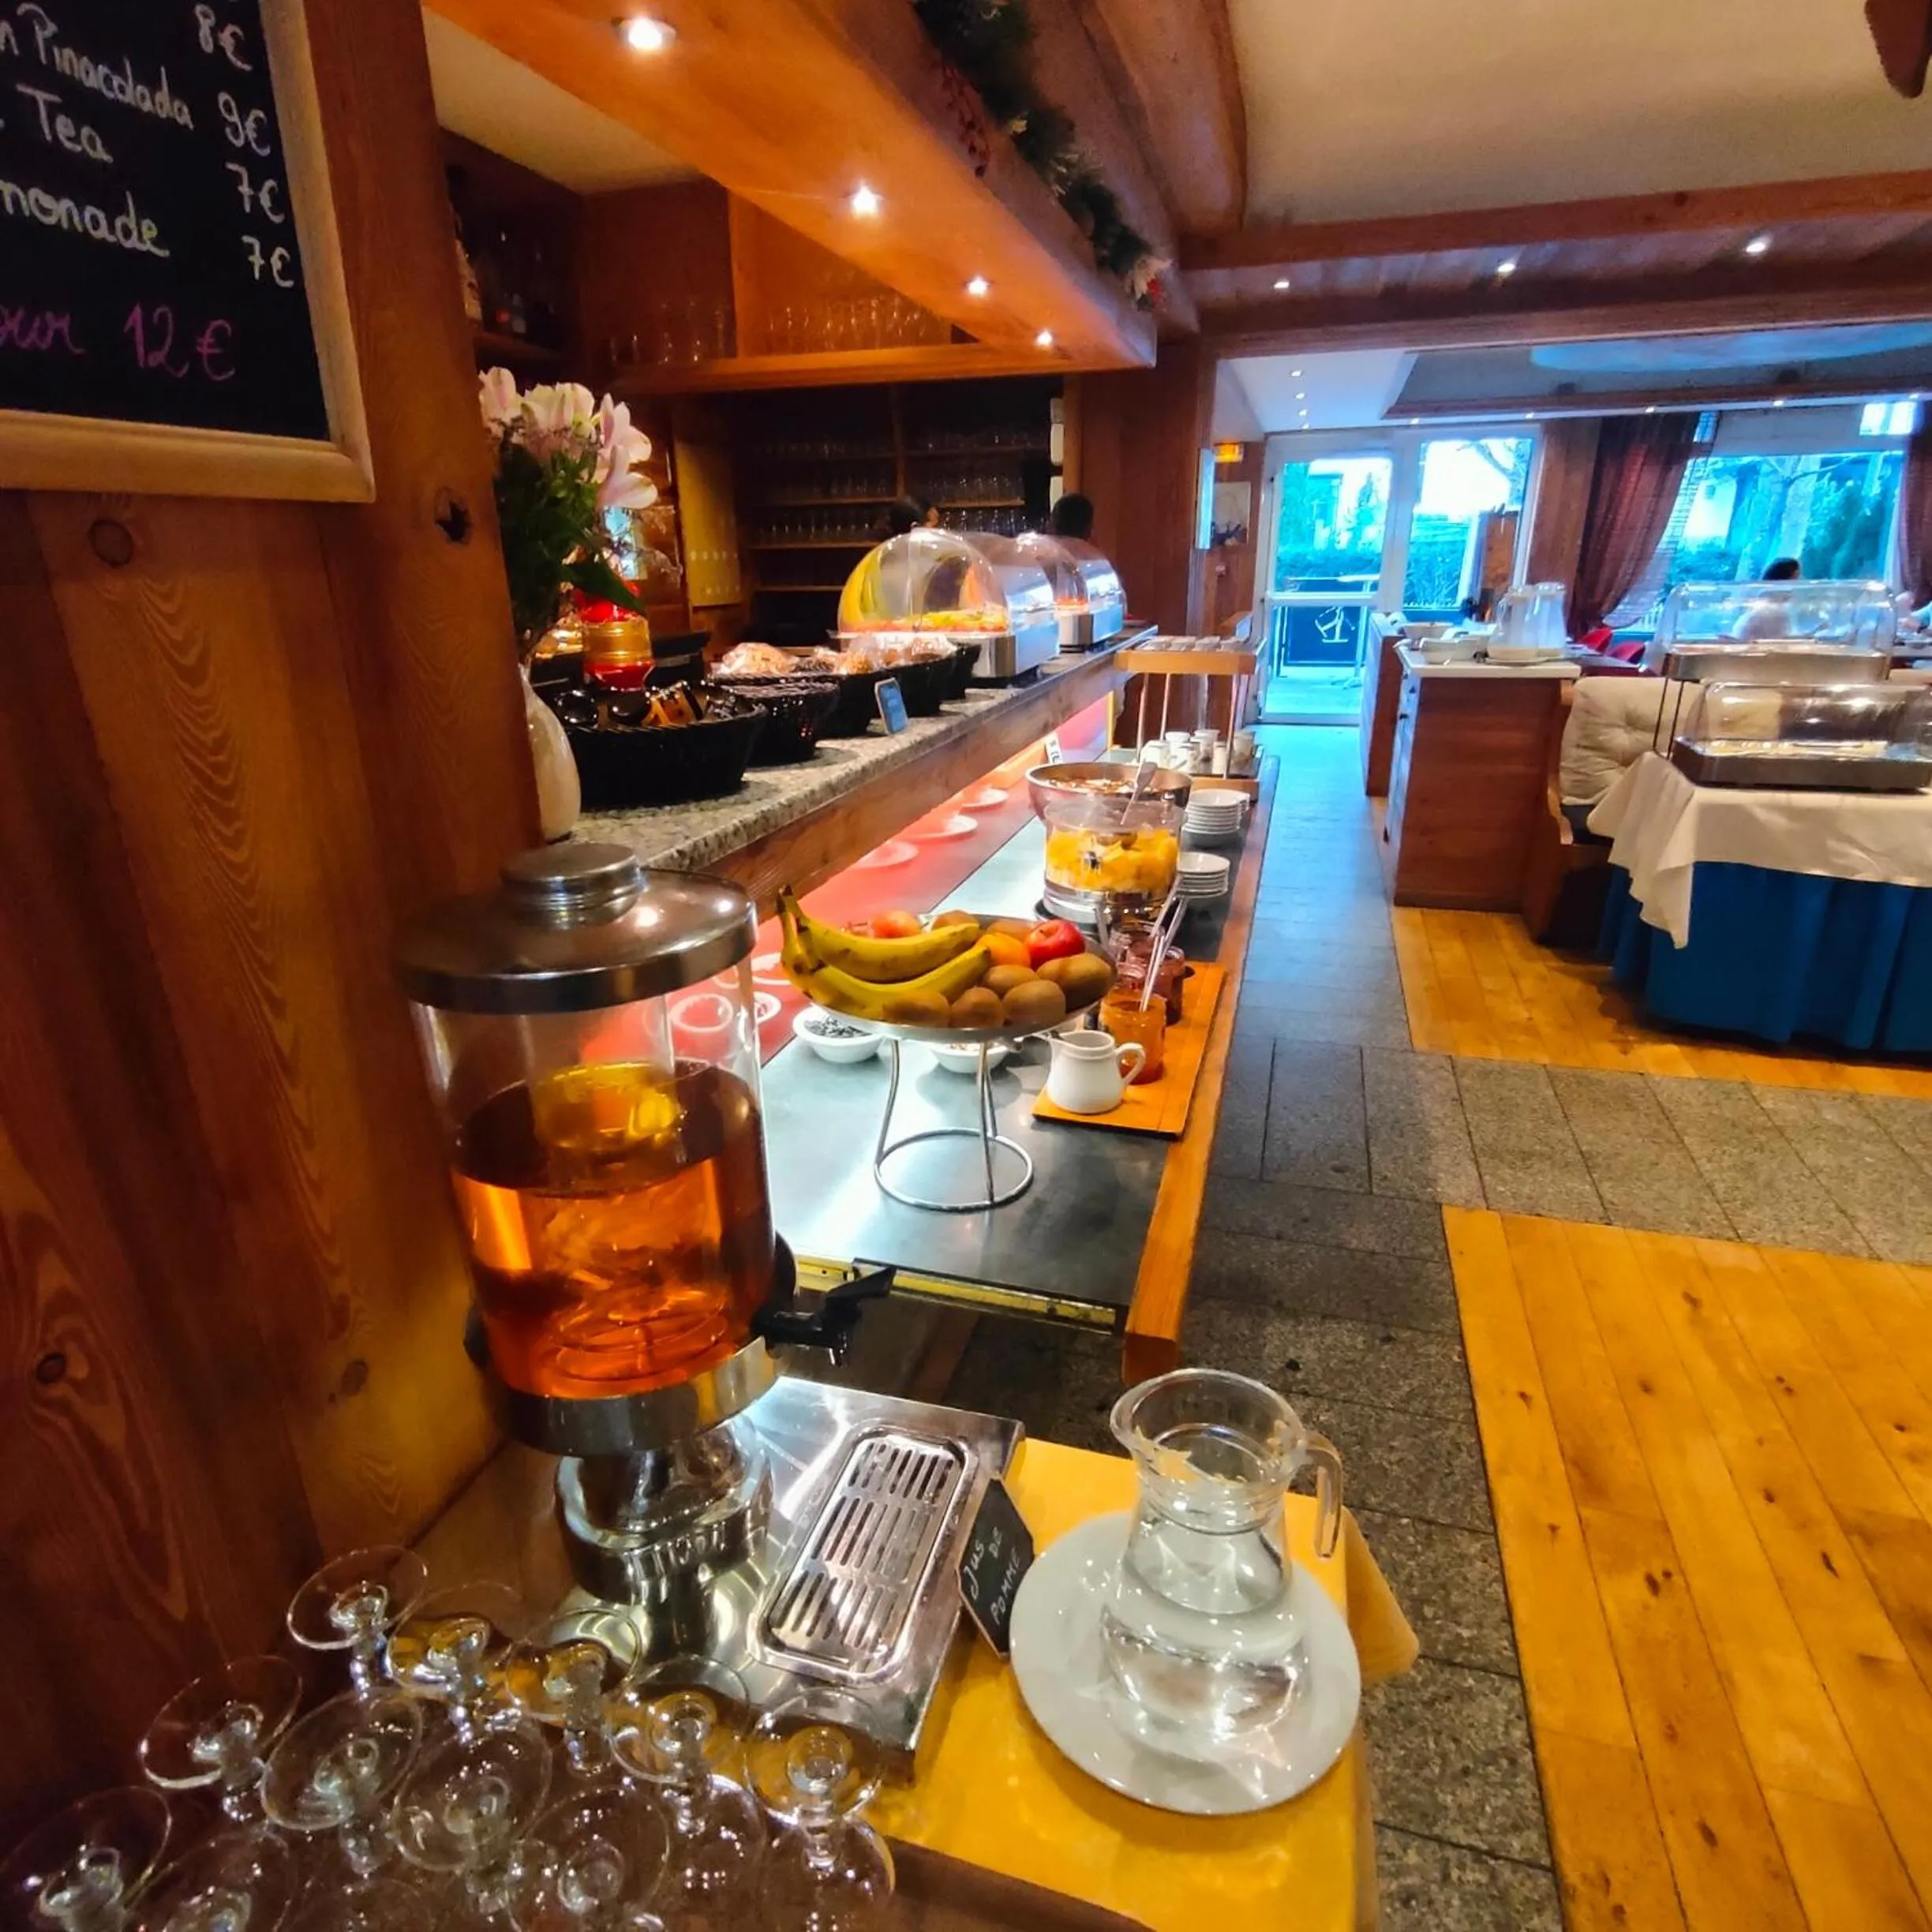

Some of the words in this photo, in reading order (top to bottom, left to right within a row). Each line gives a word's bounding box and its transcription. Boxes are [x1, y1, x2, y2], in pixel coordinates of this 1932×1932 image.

[16, 83, 114, 163] Tea
[226, 161, 286, 223] 7€
[218, 92, 271, 156] 9€
[242, 235, 294, 287] 7€
